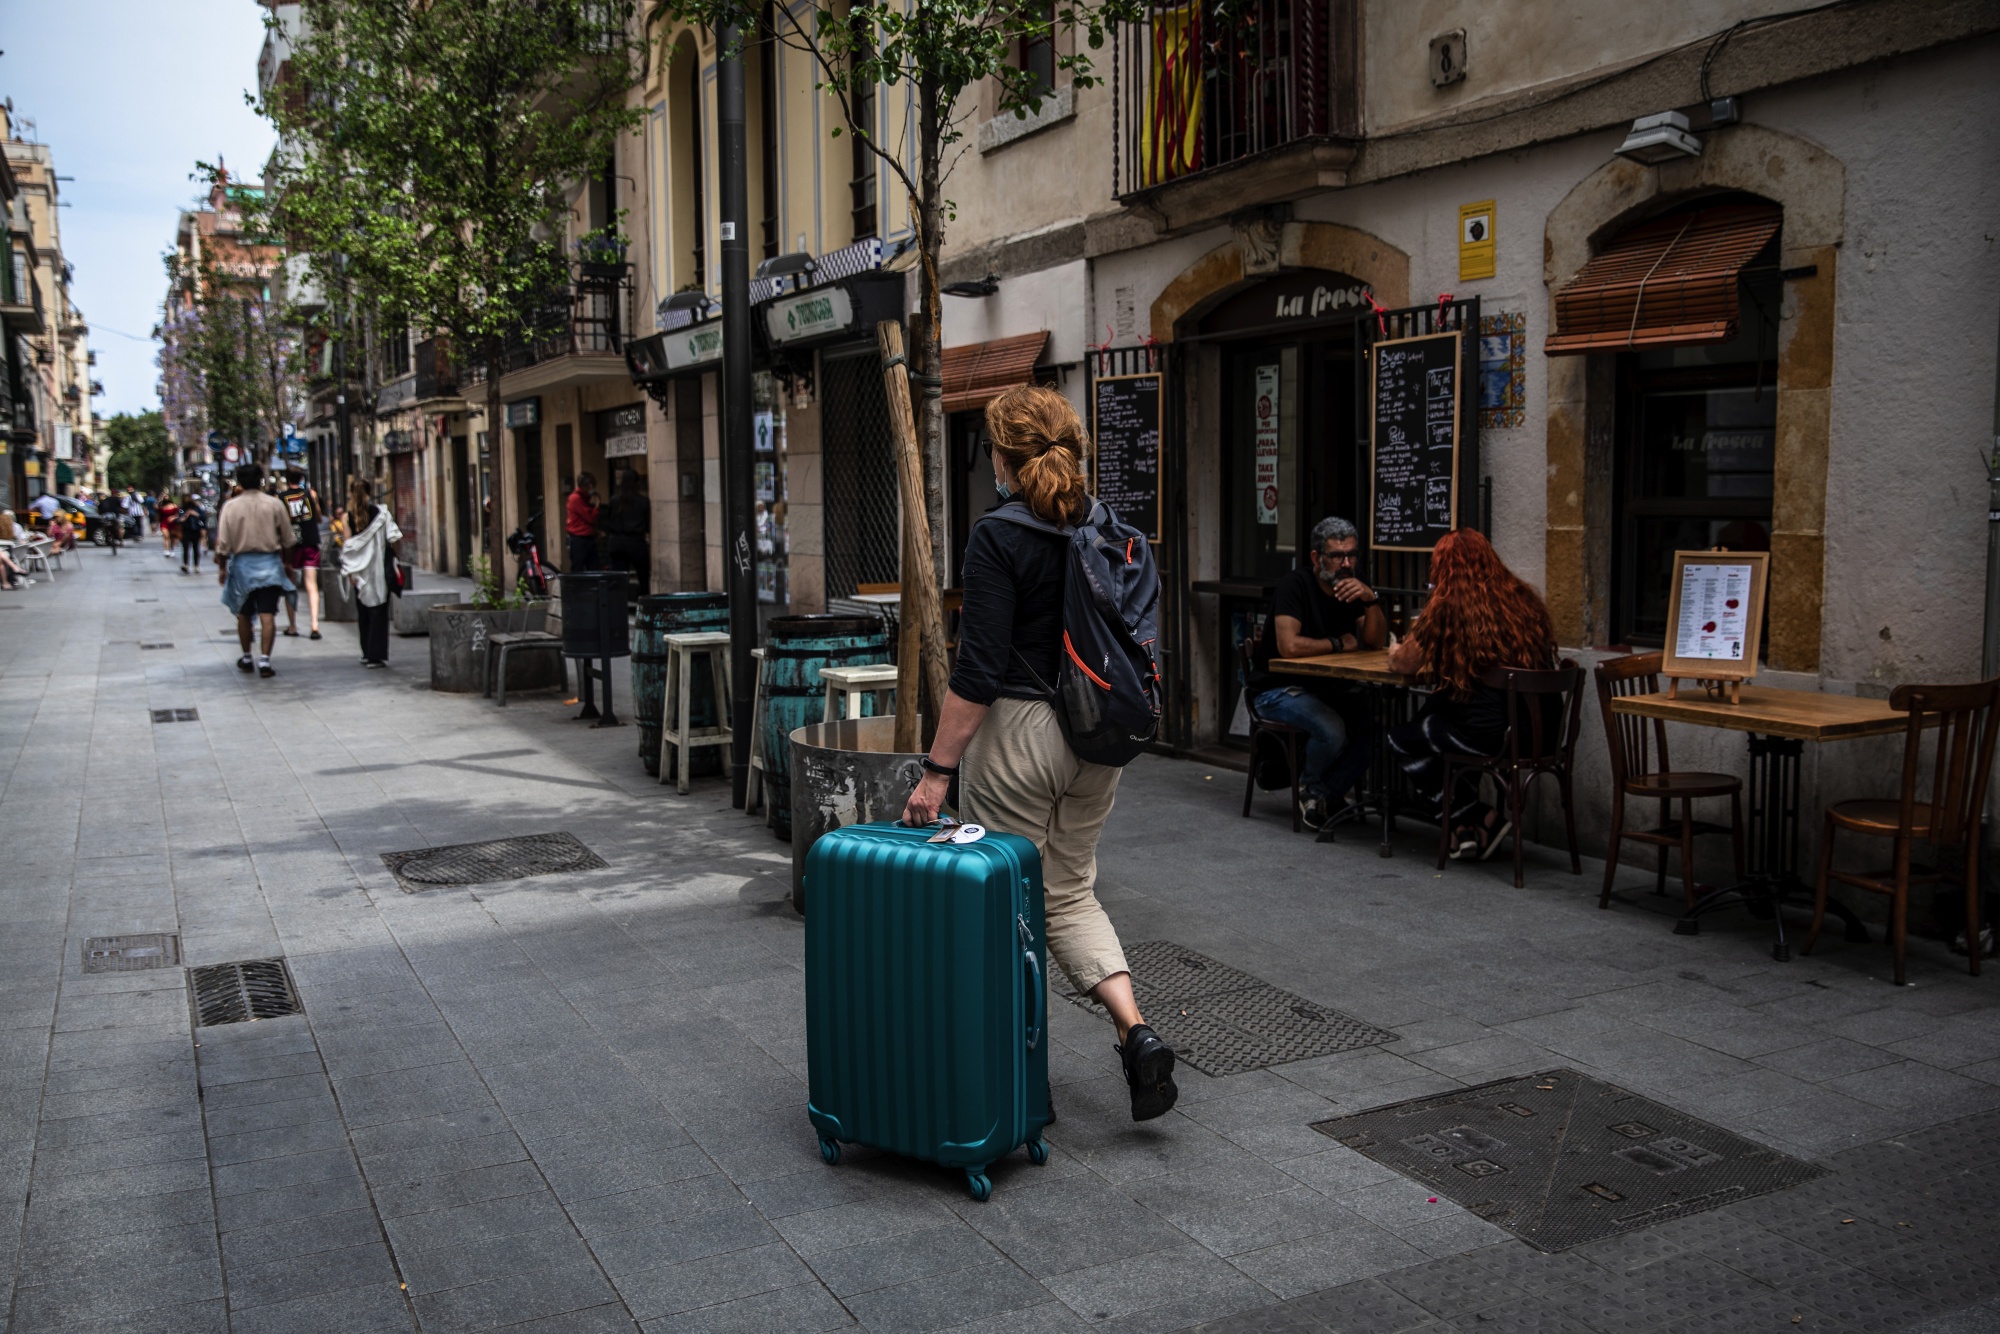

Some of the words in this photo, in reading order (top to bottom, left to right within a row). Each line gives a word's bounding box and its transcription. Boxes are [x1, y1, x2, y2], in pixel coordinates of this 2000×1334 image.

[1276, 295, 1304, 318] La
[615, 409, 641, 426] KITCHEN
[1671, 436, 1696, 450] La
[1700, 432, 1765, 452] fresca
[1258, 463, 1273, 472] TAKE
[1257, 474, 1275, 483] AWAY
